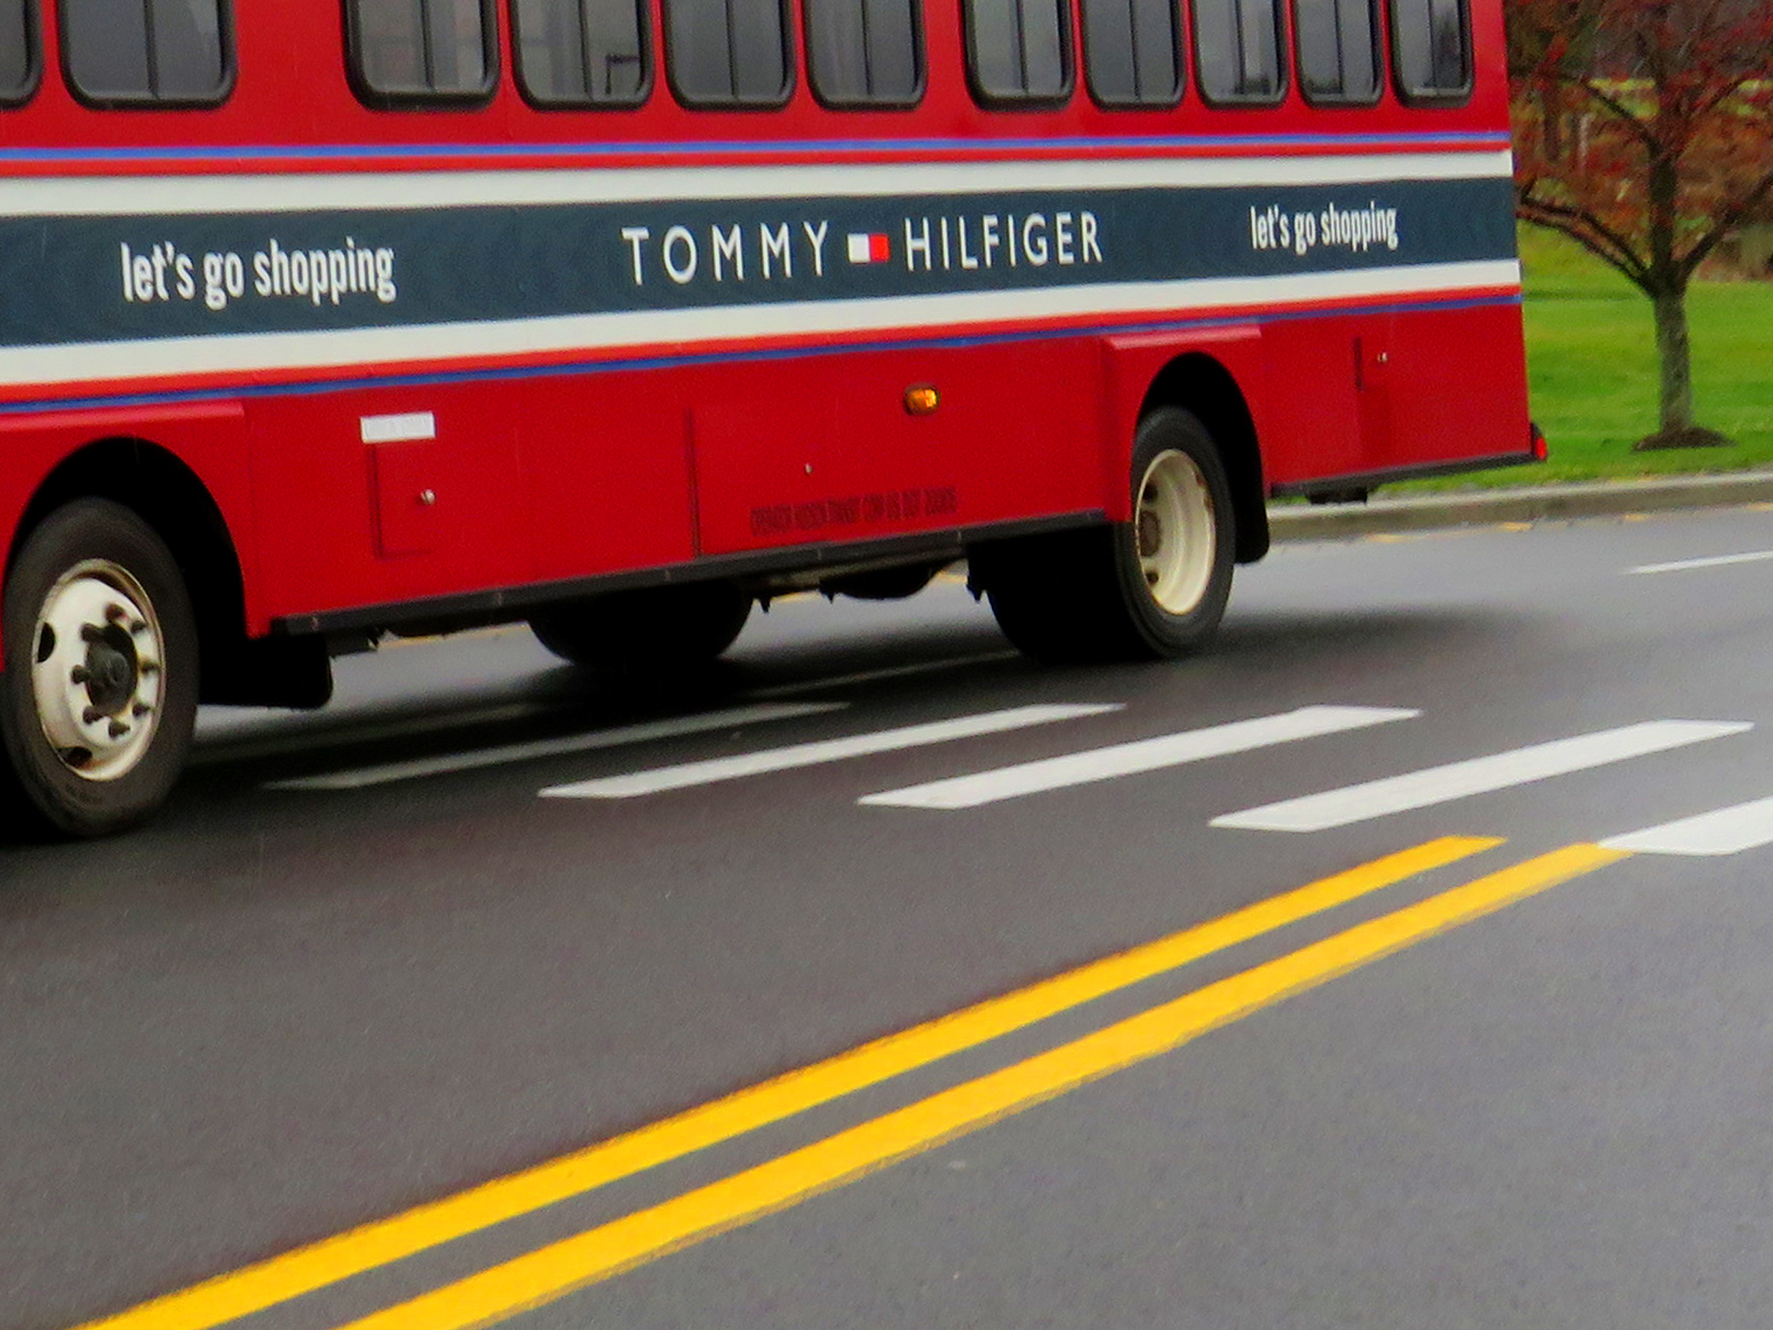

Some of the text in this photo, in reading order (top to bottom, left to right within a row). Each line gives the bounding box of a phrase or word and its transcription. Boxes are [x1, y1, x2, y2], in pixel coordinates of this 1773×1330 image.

[621, 211, 1103, 285] TOMMY HILFIGER
[1251, 200, 1399, 255] let's go shopping
[121, 236, 397, 311] let's go shopping
